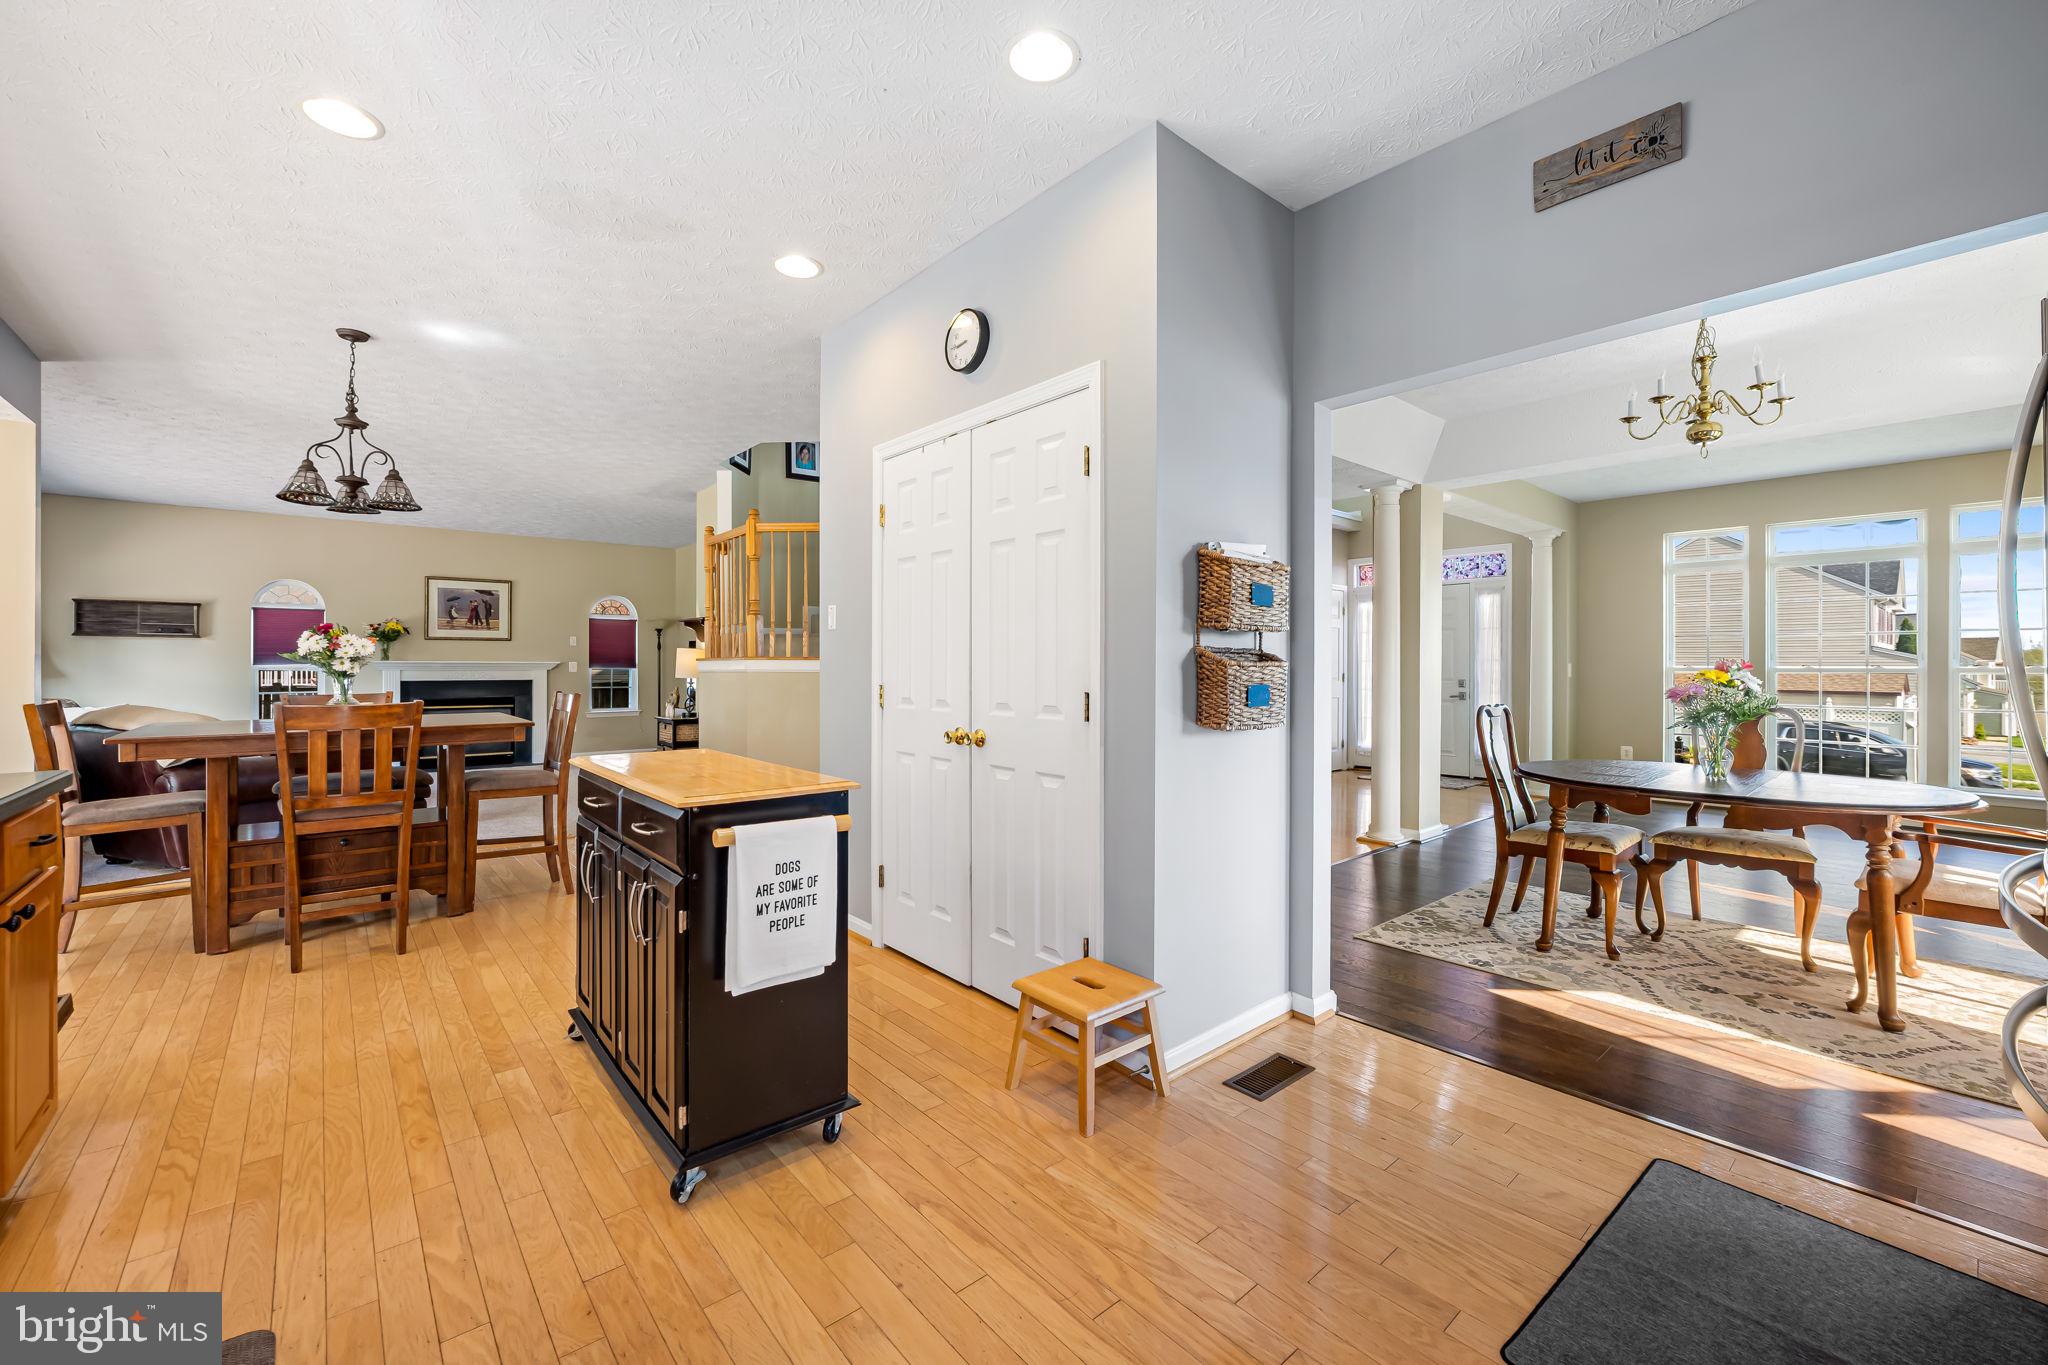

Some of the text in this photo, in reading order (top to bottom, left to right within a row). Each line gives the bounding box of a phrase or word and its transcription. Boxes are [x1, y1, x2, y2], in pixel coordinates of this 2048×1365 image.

[1574, 147, 1598, 176] let
[775, 860, 801, 876] DOGS
[755, 874, 819, 898] ARE SOME OF
[756, 893, 818, 917] MY FAVORITE
[769, 913, 806, 933] PEOPLE
